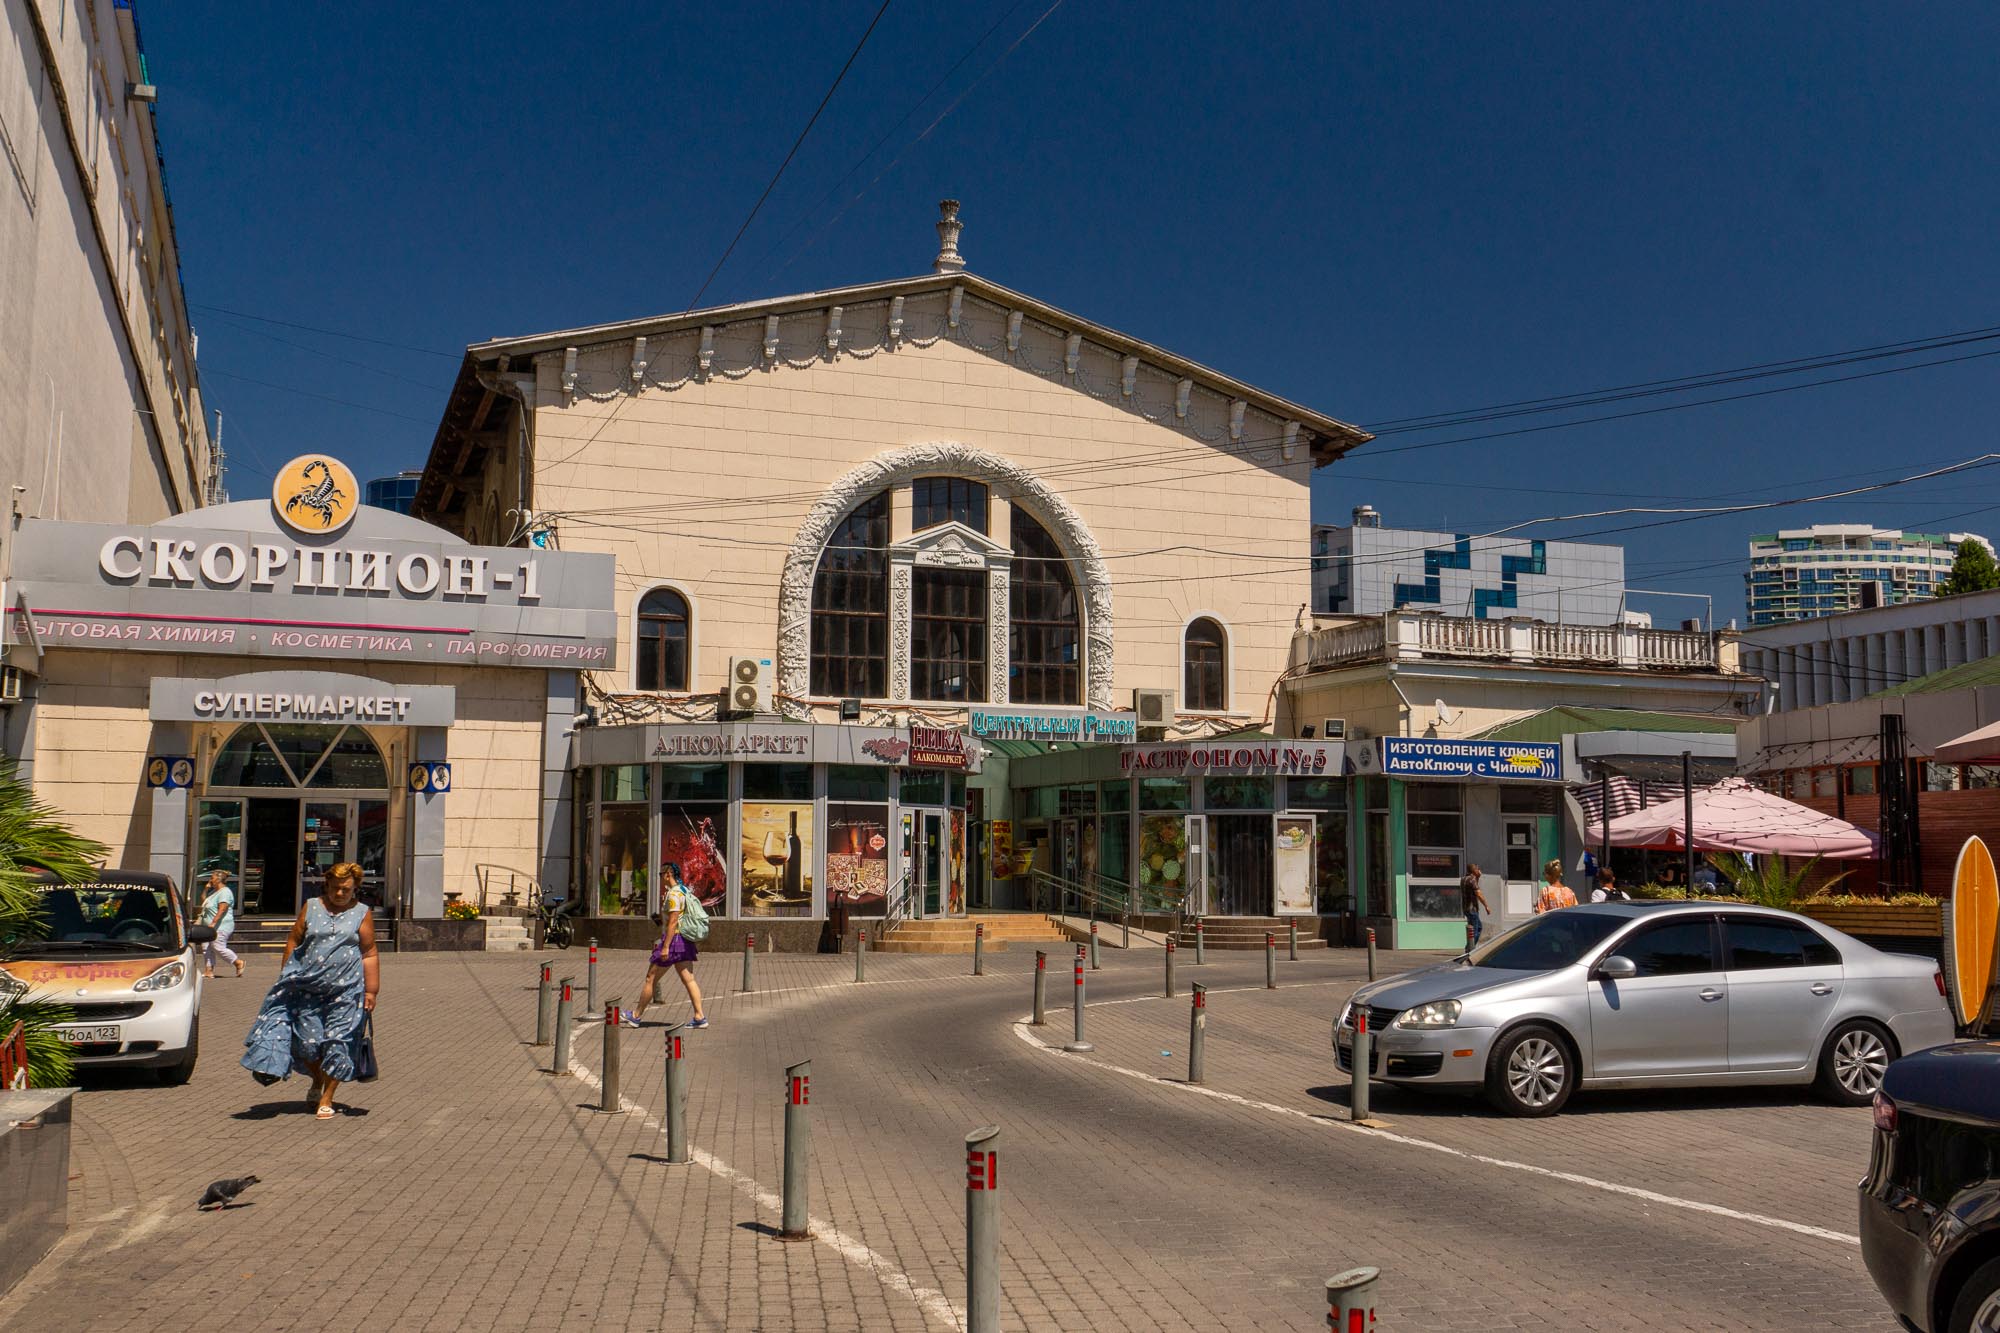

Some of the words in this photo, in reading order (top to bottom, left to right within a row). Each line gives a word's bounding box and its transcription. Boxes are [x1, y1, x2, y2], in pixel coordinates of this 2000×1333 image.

[100, 536, 541, 599] СКОРПИОН-1
[12, 619, 141, 639] БЫТОВАЯ
[148, 625, 237, 644] ХИМИЯ
[271, 631, 414, 652] КОСМЕТИКА
[446, 640, 608, 661] ПАРФЮМЕРИЯ
[194, 691, 411, 717] СУПЕРМАРКЕТ
[655, 734, 808, 755] АЛКОМАРКЕТ
[912, 726, 964, 751] НИКА
[915, 754, 963, 765] АЛКОМАРКЕТ
[1120, 748, 1279, 769] ГАСТРОНОМ
[1390, 742, 1496, 758] ИЗГОТОВЛЕНИЕ
[1500, 746, 1555, 760] КЛЮЧЕЙ
[1390, 757, 1473, 773] АвтоКлючи
[1477, 763, 1486, 773] с
[1490, 760, 1537, 775] Чипом
[31, 884, 54, 893] ДЦ
[96, 1027, 116, 1037] 123
